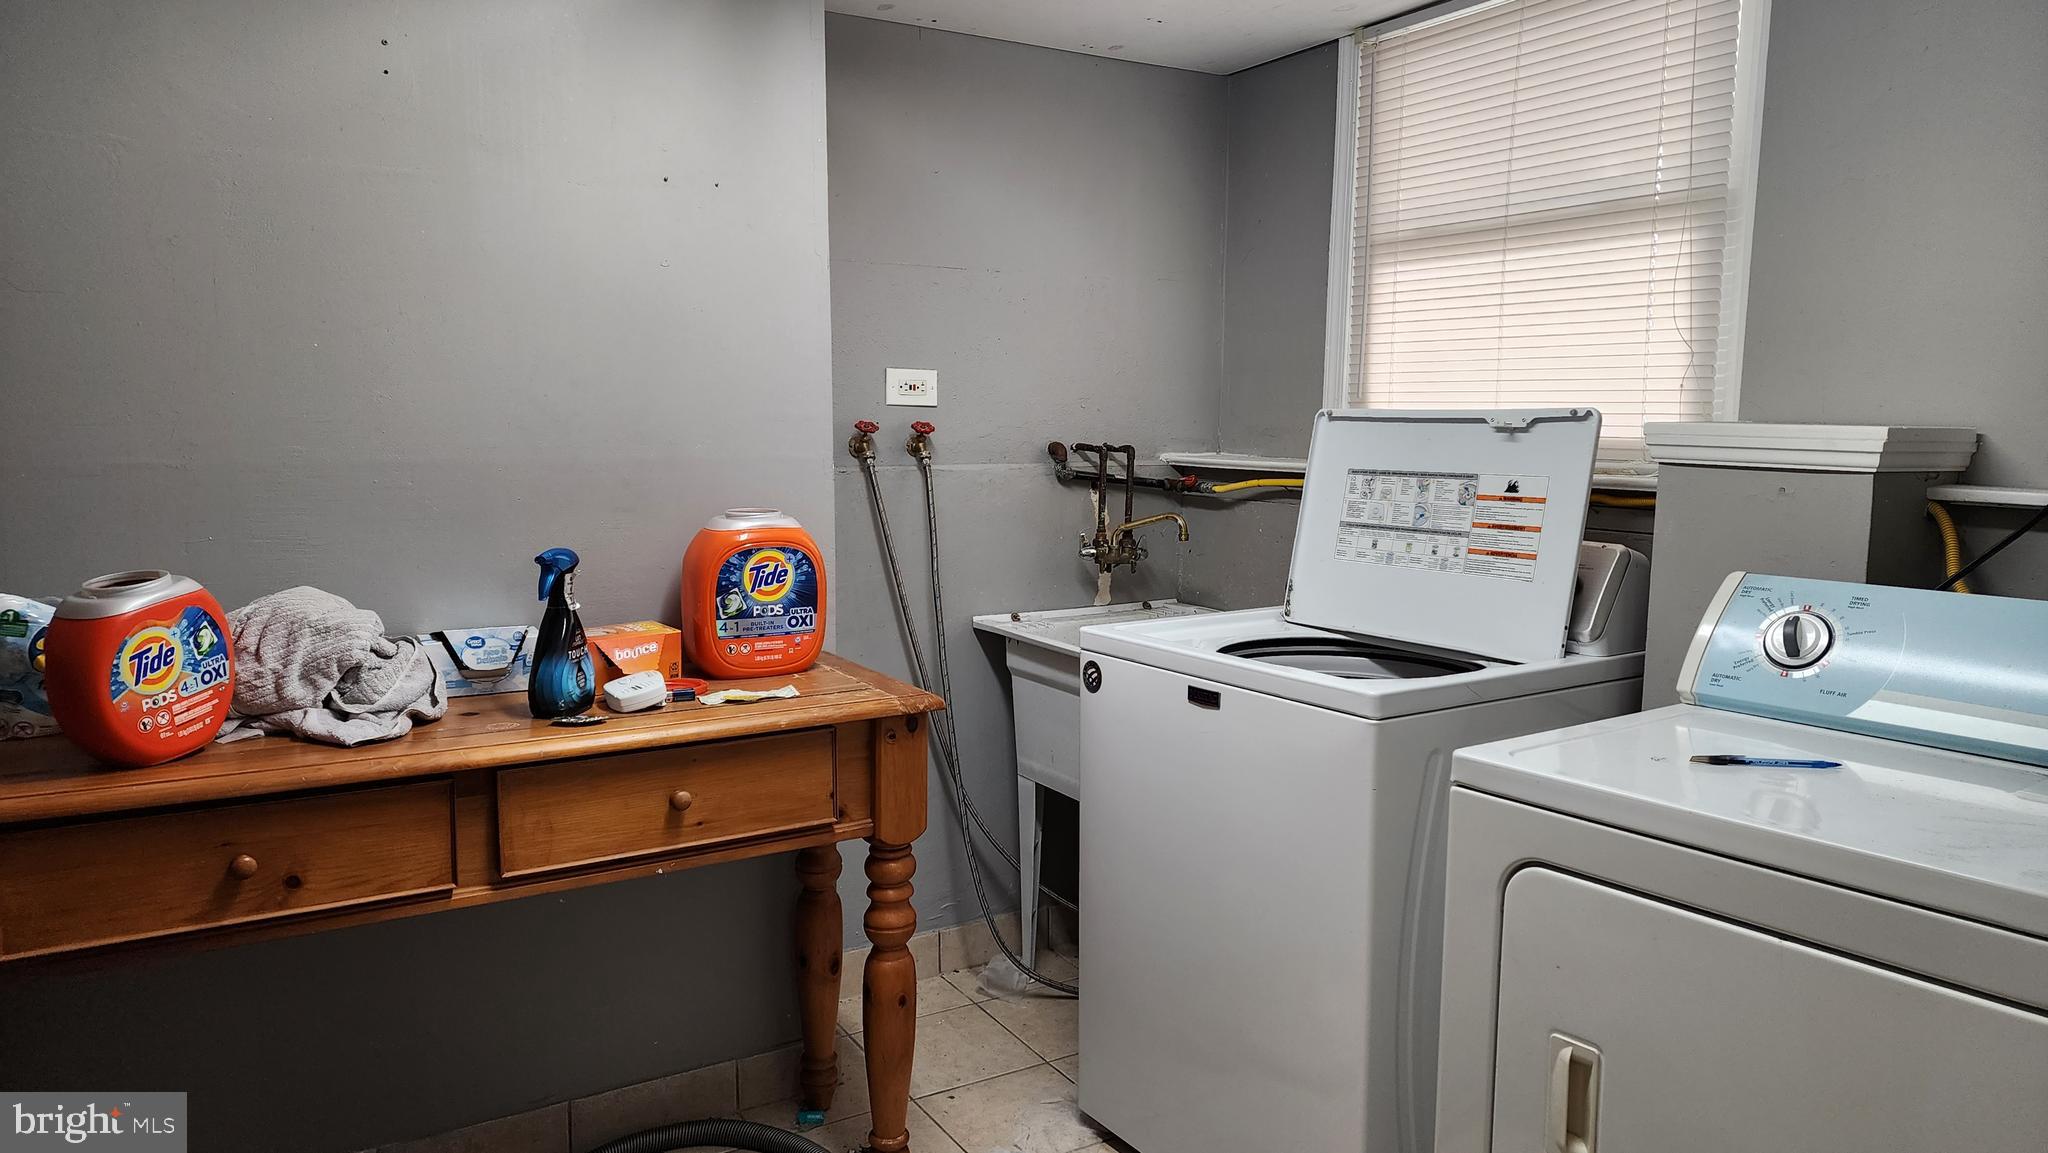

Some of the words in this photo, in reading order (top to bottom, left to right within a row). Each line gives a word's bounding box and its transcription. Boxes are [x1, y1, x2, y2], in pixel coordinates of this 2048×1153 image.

[749, 563, 789, 594] Tide
[753, 604, 784, 617] PODS
[787, 615, 813, 628] OXI
[615, 642, 658, 661] bounce
[129, 641, 176, 687] Tide
[202, 655, 225, 669] ULTRA
[201, 662, 228, 685] OXI
[1712, 673, 1743, 681] AUTOMATIC
[142, 689, 178, 712] PODS
